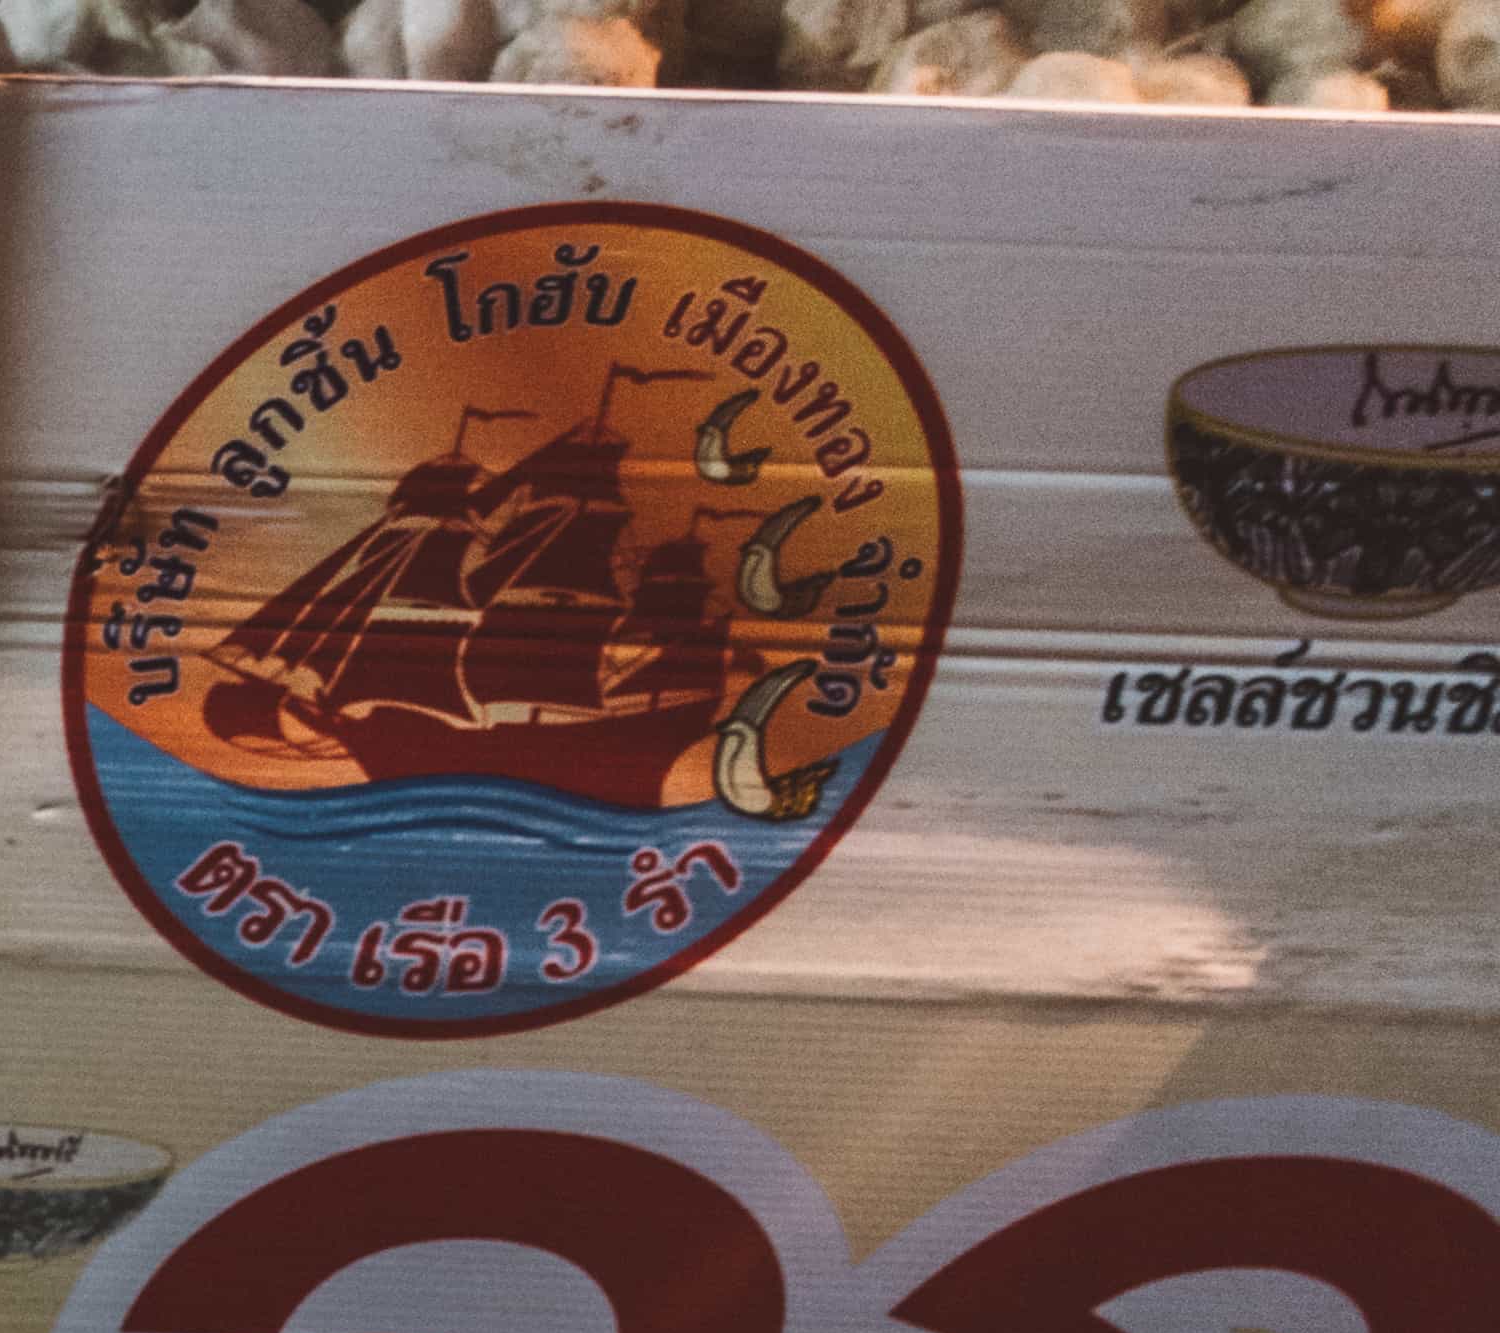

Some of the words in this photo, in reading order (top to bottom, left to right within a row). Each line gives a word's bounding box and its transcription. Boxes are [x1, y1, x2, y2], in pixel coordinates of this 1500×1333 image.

[210, 303, 403, 499] ลูกชิ้น
[423, 243, 639, 343] โกฮับ
[663, 275, 886, 514] เมืองทอง
[805, 534, 924, 718] จำกัด
[1101, 638, 1500, 735] เชลล์ชวนชิ
[176, 841, 334, 966] ตรา
[351, 897, 507, 991] เรือ
[535, 898, 598, 979] 3
